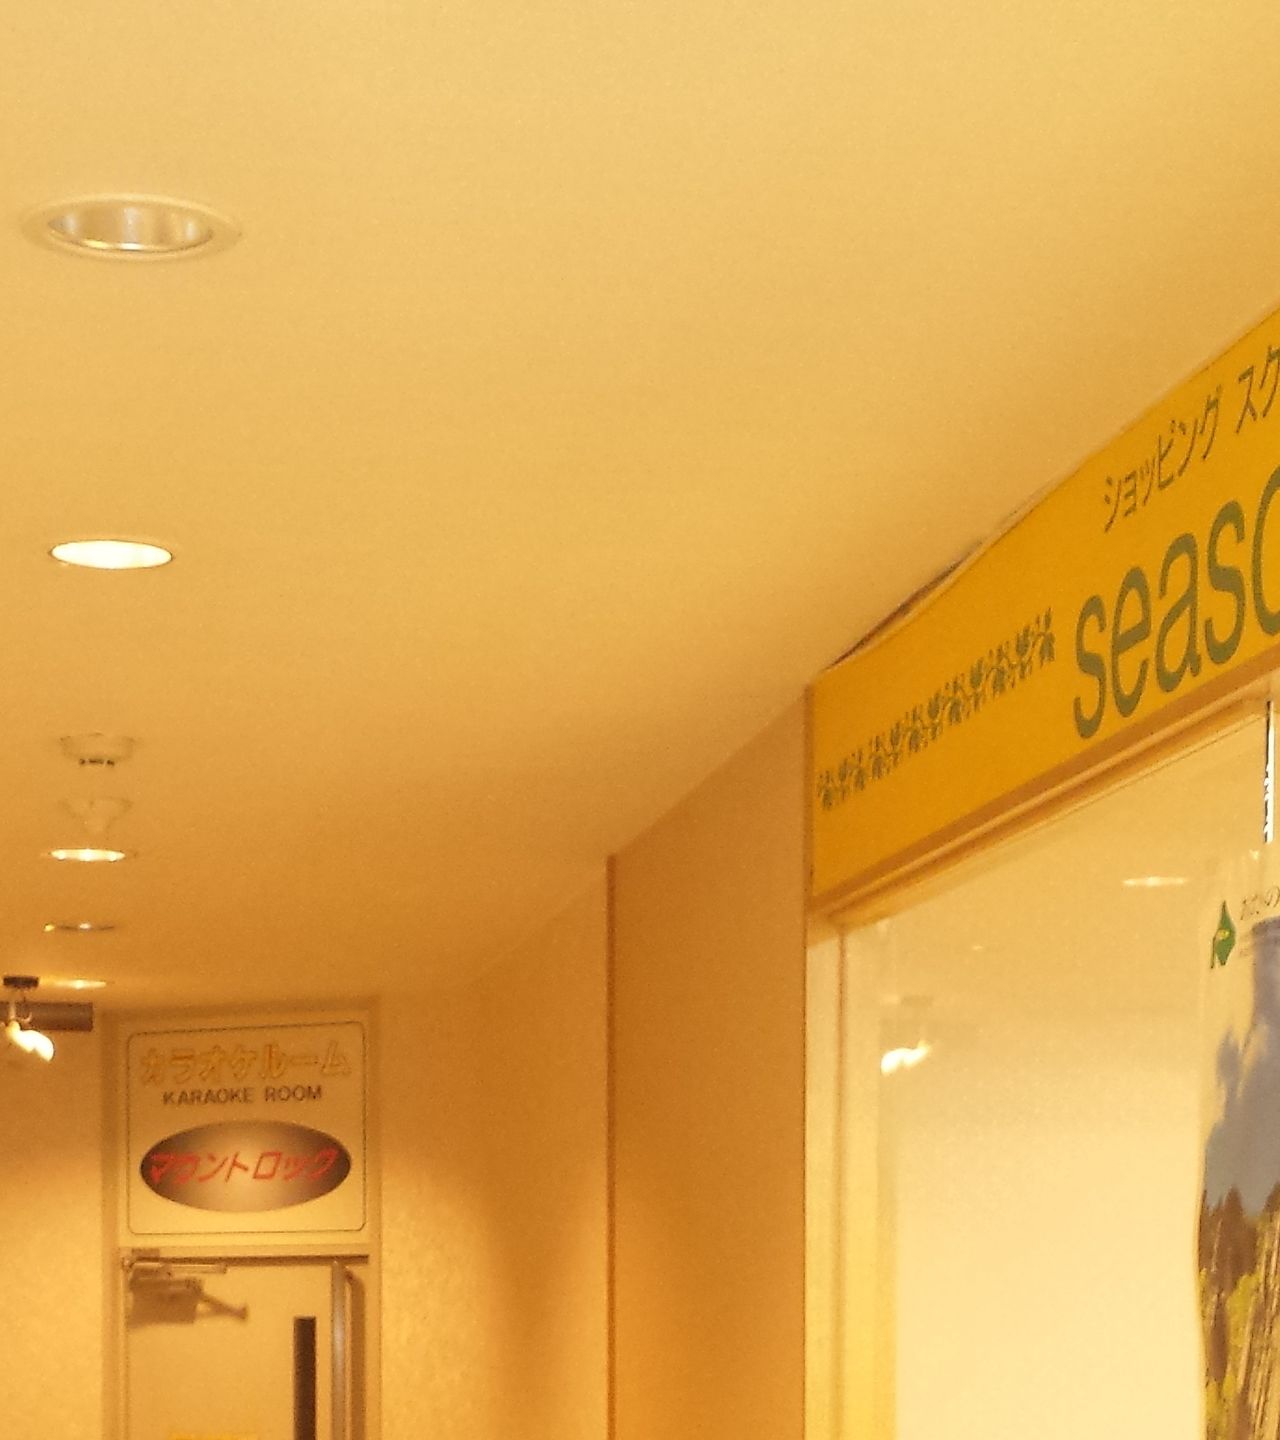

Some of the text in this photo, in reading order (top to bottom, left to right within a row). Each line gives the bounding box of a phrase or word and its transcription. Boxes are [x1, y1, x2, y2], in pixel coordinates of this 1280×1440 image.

[1104, 385, 1224, 533] ショッピング
[140, 1039, 352, 1086] カラオケルーム
[162, 1085, 323, 1106] KARAOKE ROOM
[150, 1147, 339, 1185] マウントロック
